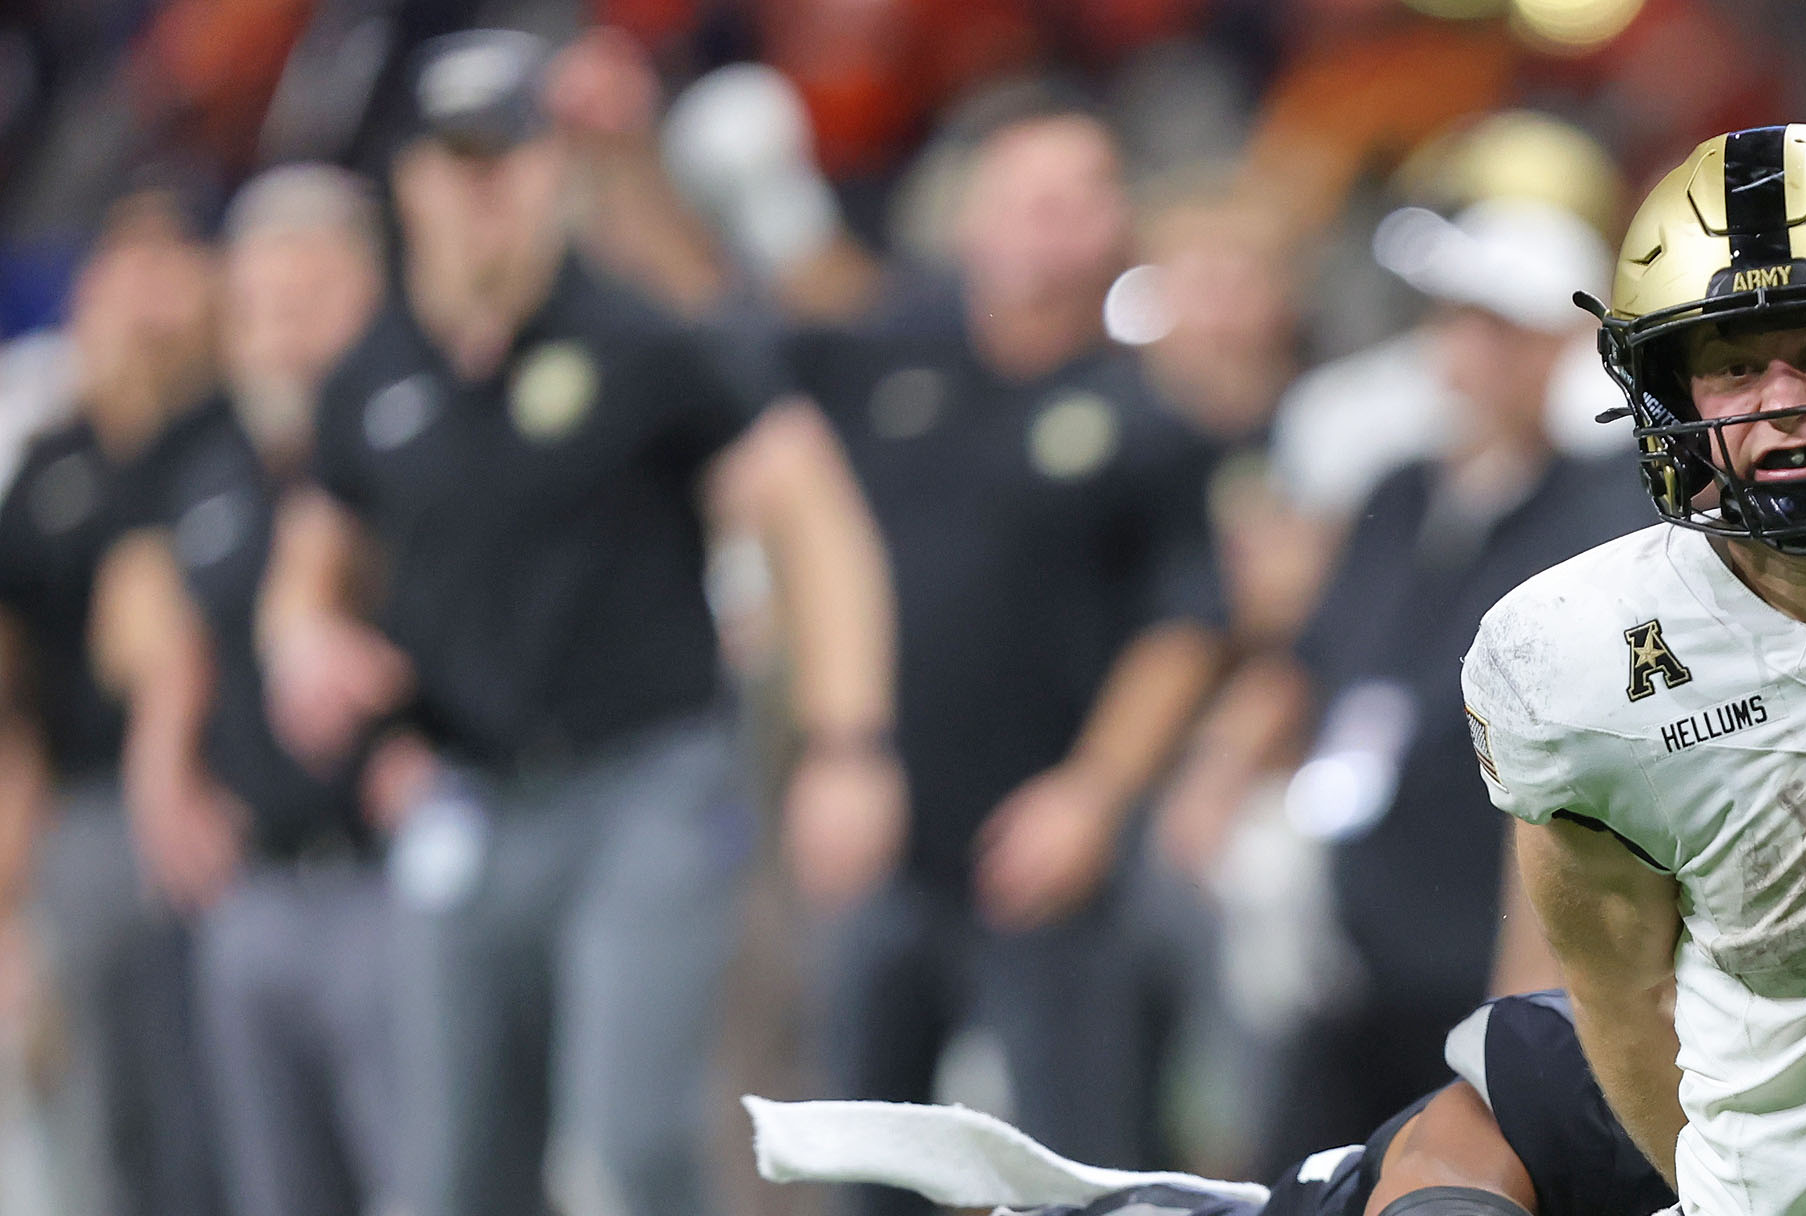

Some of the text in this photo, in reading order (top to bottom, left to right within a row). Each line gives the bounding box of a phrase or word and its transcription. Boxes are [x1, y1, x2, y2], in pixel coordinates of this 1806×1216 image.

[1732, 265, 1792, 292] ARMY
[1624, 618, 1693, 702] A
[1661, 695, 1767, 753] HELLUMS
